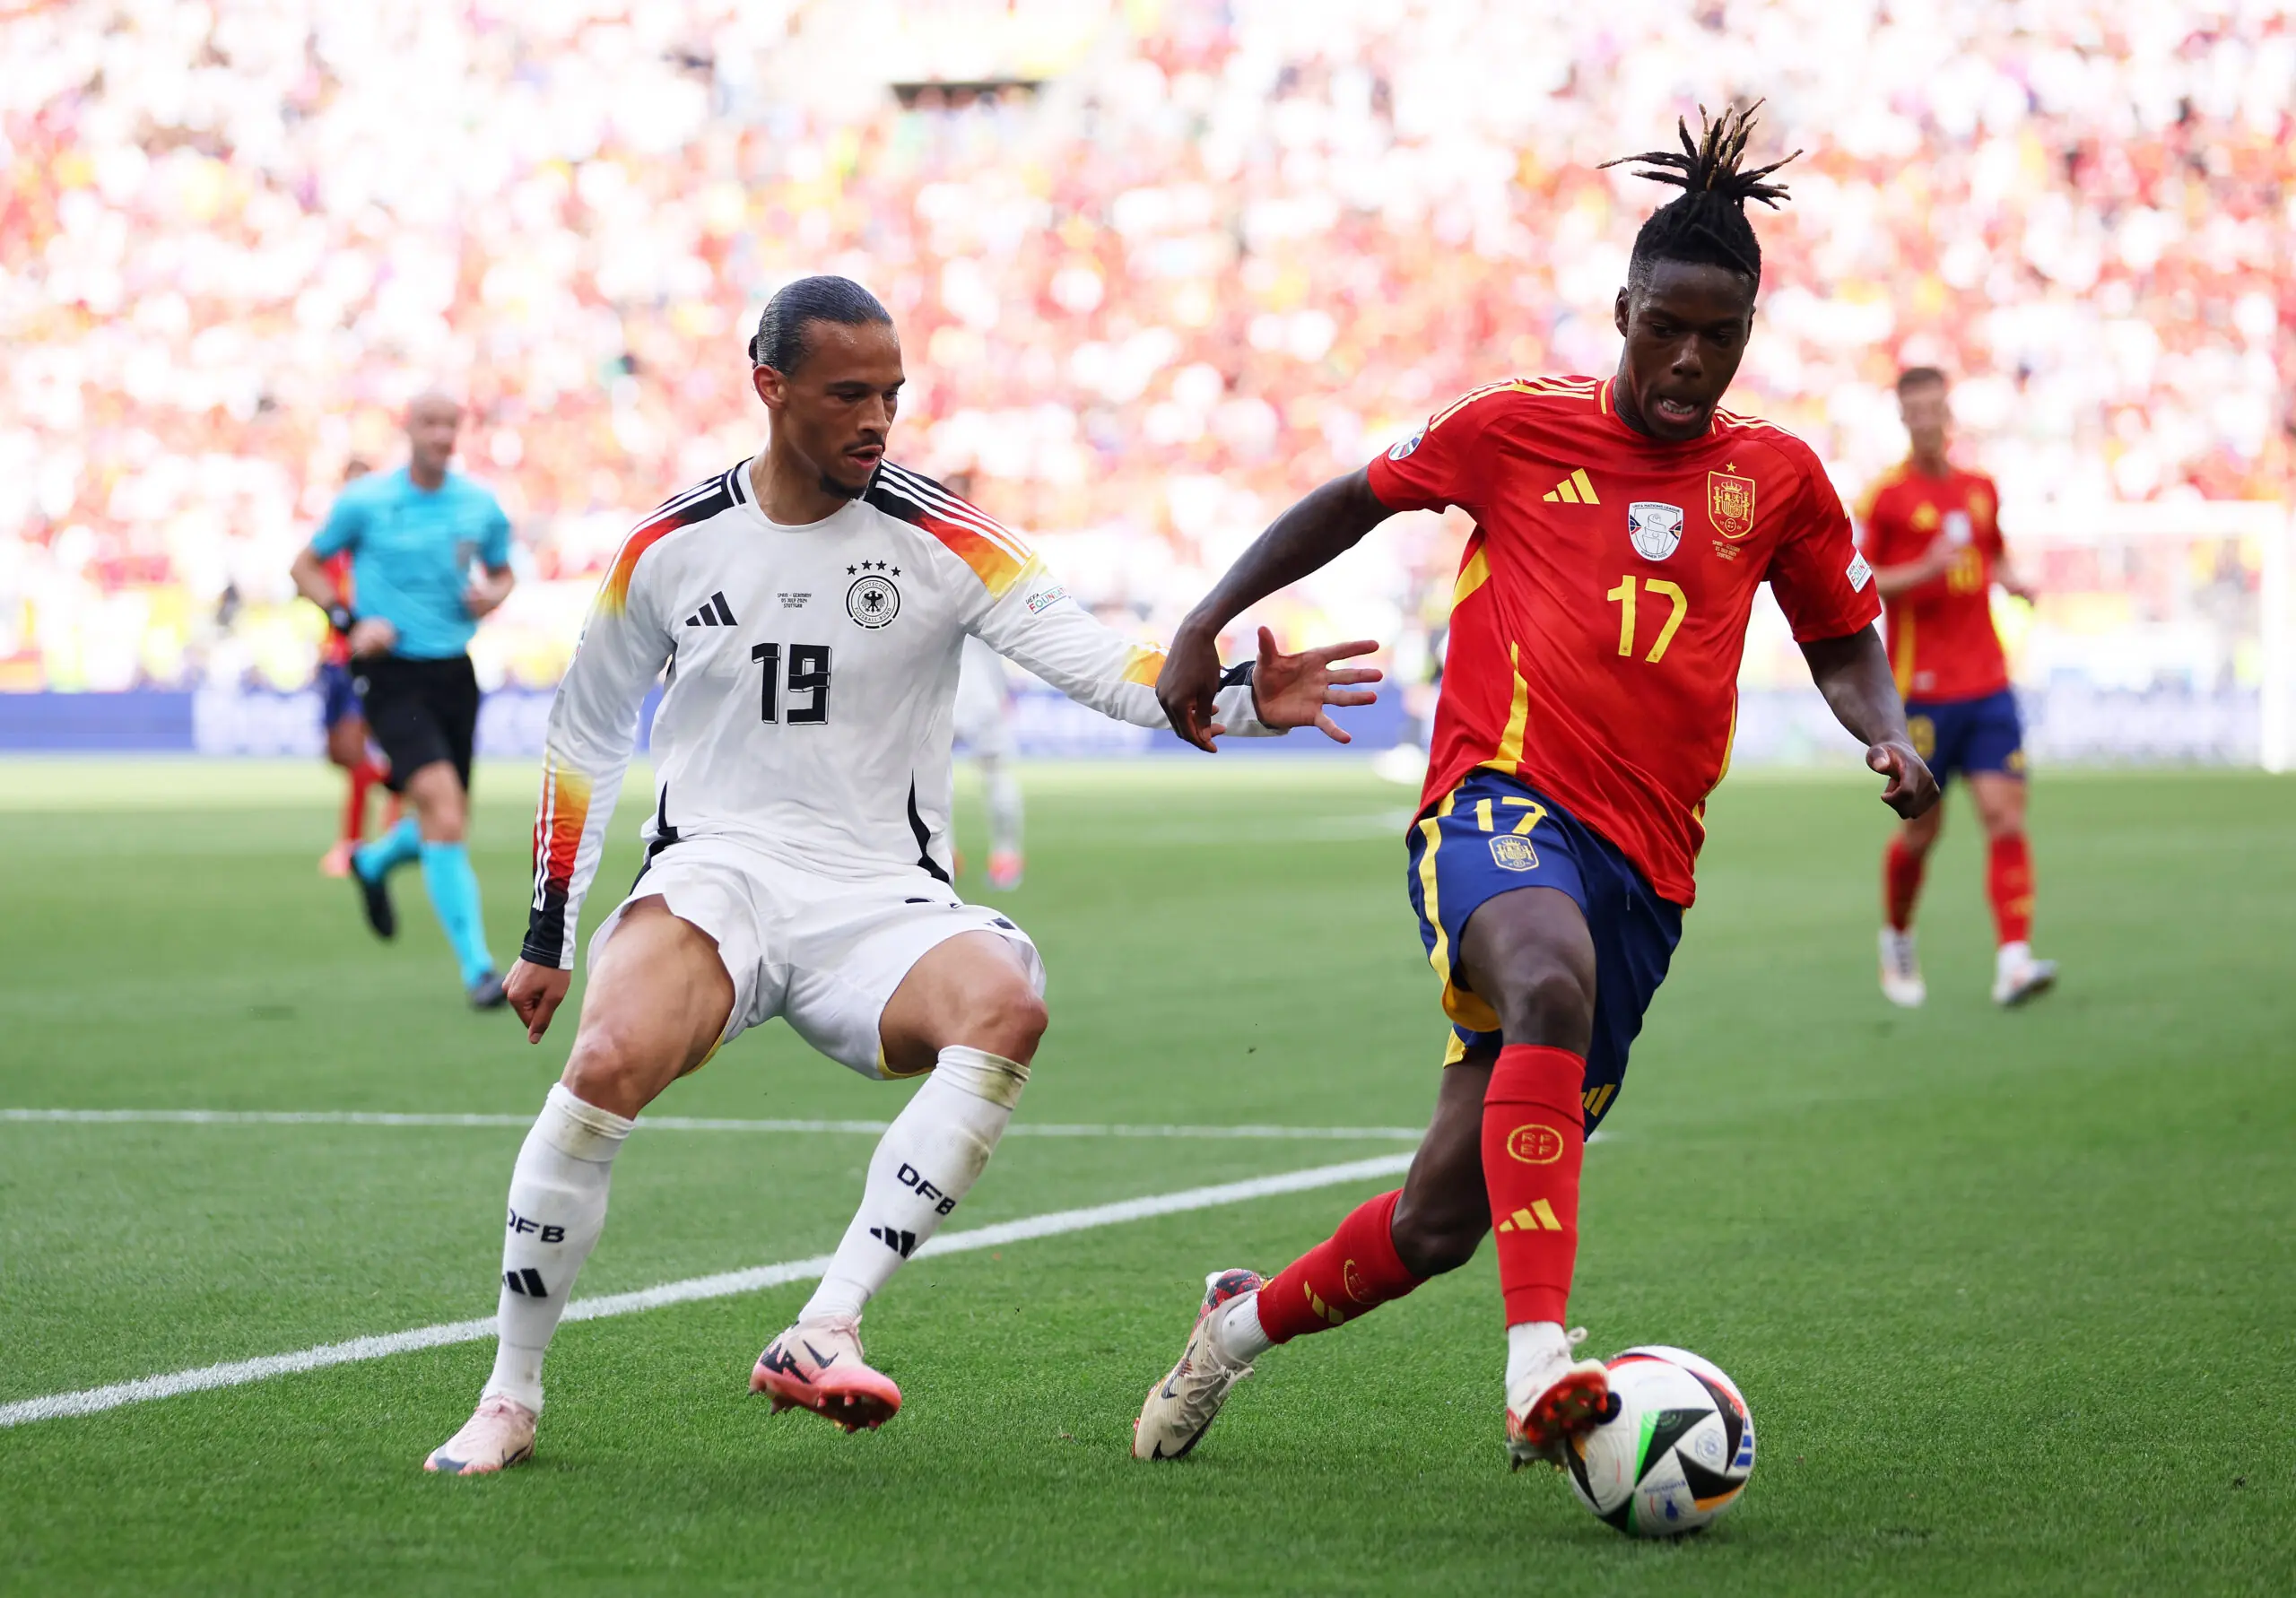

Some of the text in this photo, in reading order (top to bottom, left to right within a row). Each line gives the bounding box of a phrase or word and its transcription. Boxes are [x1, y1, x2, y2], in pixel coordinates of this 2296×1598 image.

[858, 582, 889, 592] DEUTSCHER
[1025, 592, 1039, 604] UEFA
[1607, 574, 1688, 664] 17
[752, 642, 832, 725] 19
[1473, 795, 1548, 835] 17
[897, 1162, 956, 1216] DFB
